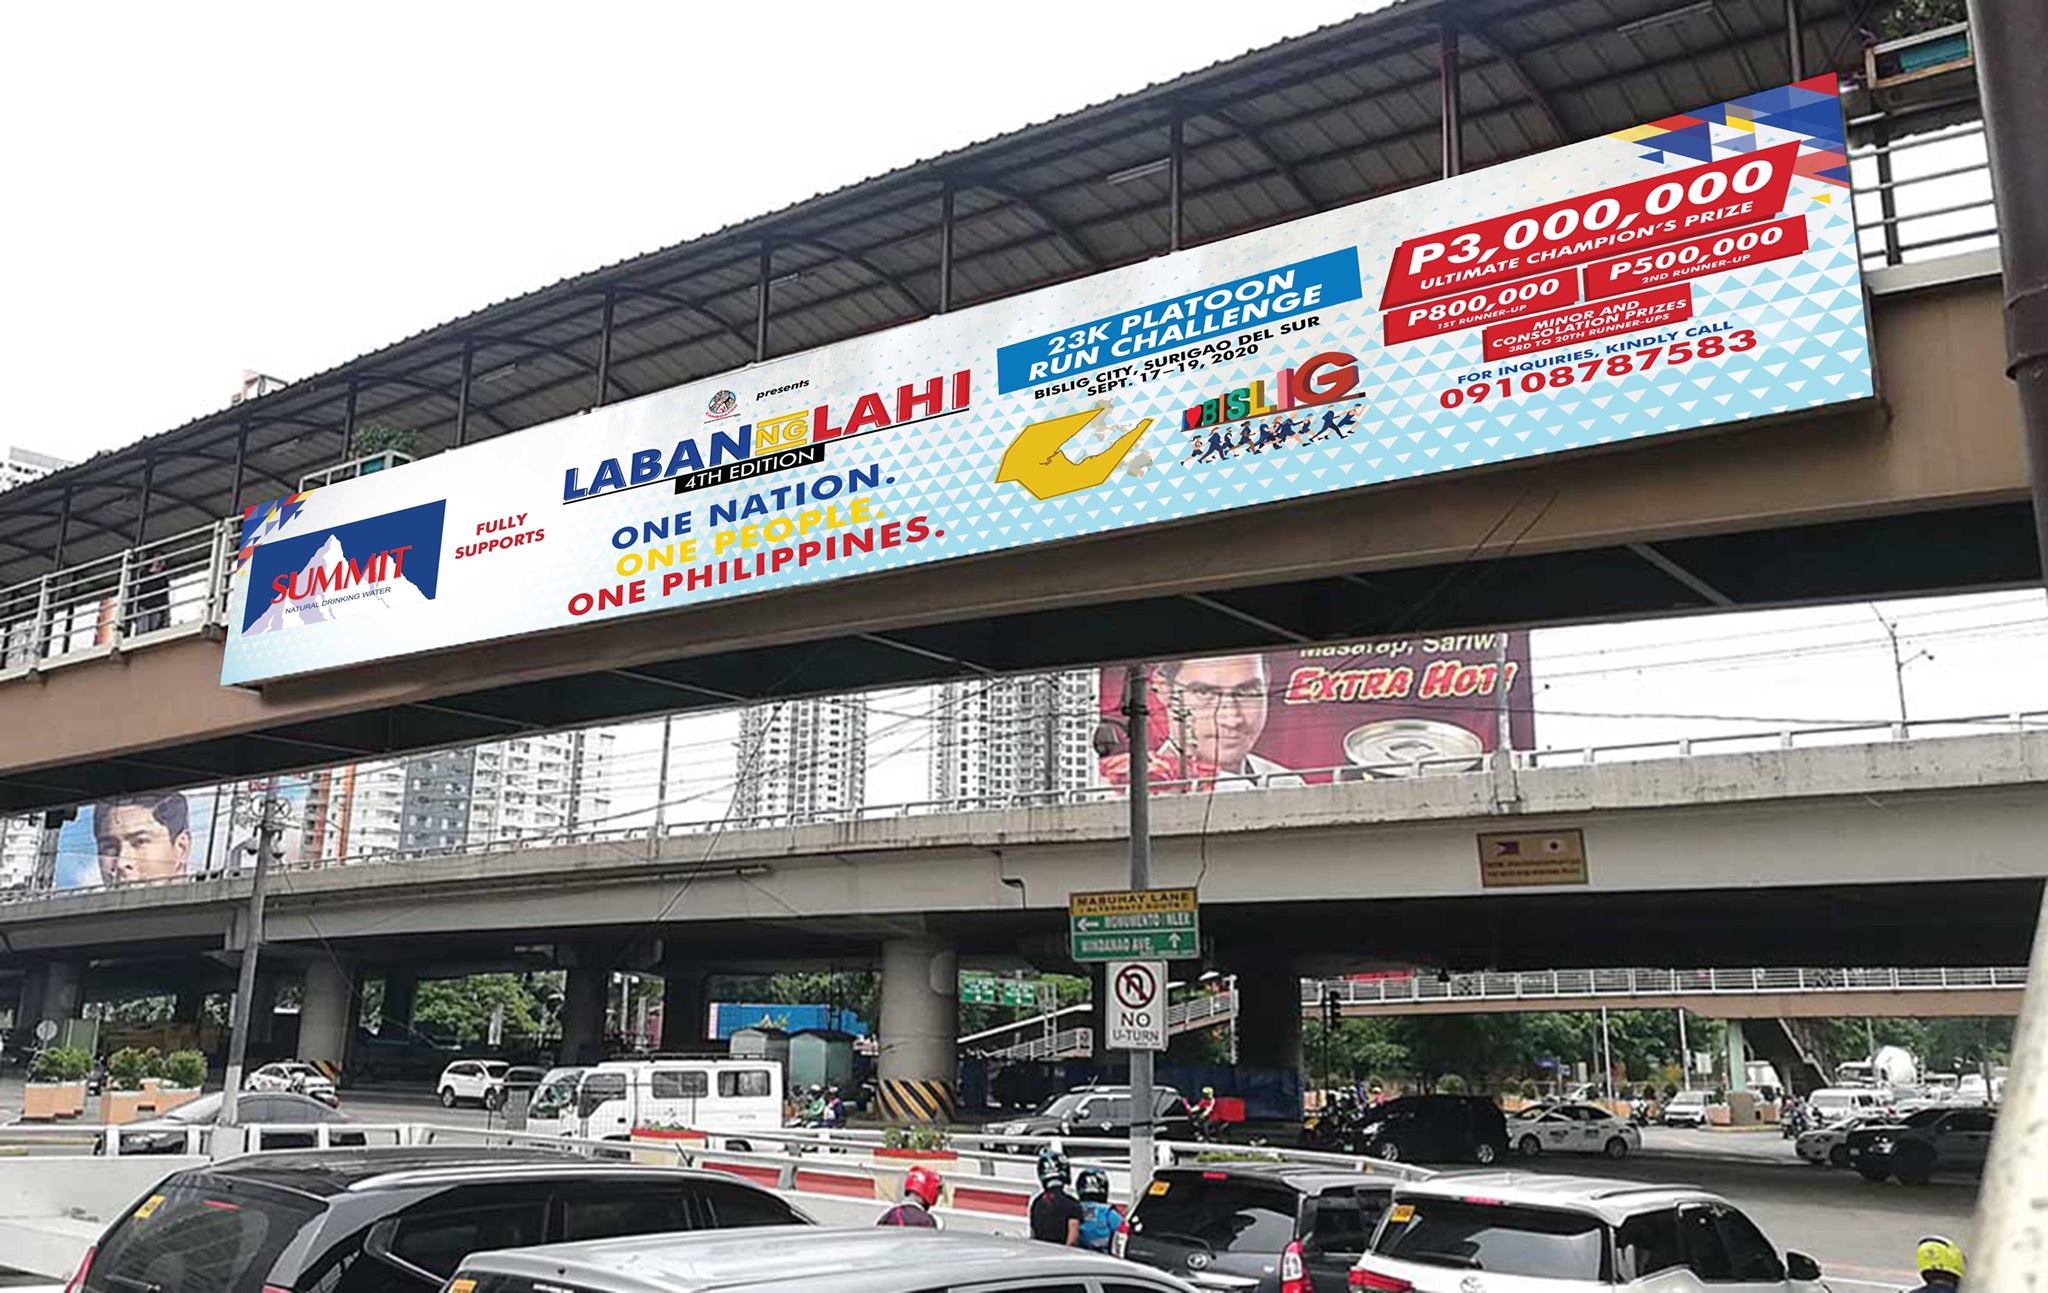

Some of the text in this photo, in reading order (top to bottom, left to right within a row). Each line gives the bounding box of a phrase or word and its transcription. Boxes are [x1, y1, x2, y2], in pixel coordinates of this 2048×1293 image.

[1408, 159, 1773, 275] P3,000,000
[1419, 200, 1753, 290] ULTIMATE CHAMPION'S PRIZE
[1609, 226, 1783, 281] P500,000
[1641, 254, 1751, 284] 2ND RUNNER-UP
[1047, 269, 1296, 357] 23K PLATOON
[1408, 278, 1559, 327] P800,000
[1437, 304, 1527, 330] 1ST RUNNER-UP
[1492, 299, 1687, 349] CONSOLATION PRIZES
[1533, 300, 1640, 330] MINOR AND
[1028, 283, 1322, 382] RUN CHALLENGE
[1034, 315, 1320, 400] BISLIG CITY, SURIGAO DEL SUR
[1458, 320, 1734, 385] FOR INQUIRIES, KINDLY CALL
[1508, 313, 1670, 353] 3RD TO 20TH RUNNER-UPS
[756, 379, 810, 400] presents
[1087, 379, 1133, 396] SEPT.
[1211, 343, 1258, 366] 2020
[1202, 351, 1361, 426] BISLIG
[1440, 328, 1758, 410] 09108787583
[563, 369, 970, 500] LABAN NG LAHI
[685, 448, 815, 491] 4TH EDITION
[476, 513, 528, 535] FULLY
[612, 464, 896, 550] ONE NATION.
[455, 529, 545, 559] SUPPORTS
[615, 497, 886, 577] ONE PEOPLE.
[272, 545, 412, 605] SUMMIT
[568, 515, 945, 617] ONE PHILIPPINES.
[285, 587, 391, 614] NATURAL DRINKING WATER
[1078, 896, 1145, 905] MABUHAY
[1113, 1031, 1159, 1041] U-TURN
[1121, 1013, 1151, 1027] NO
